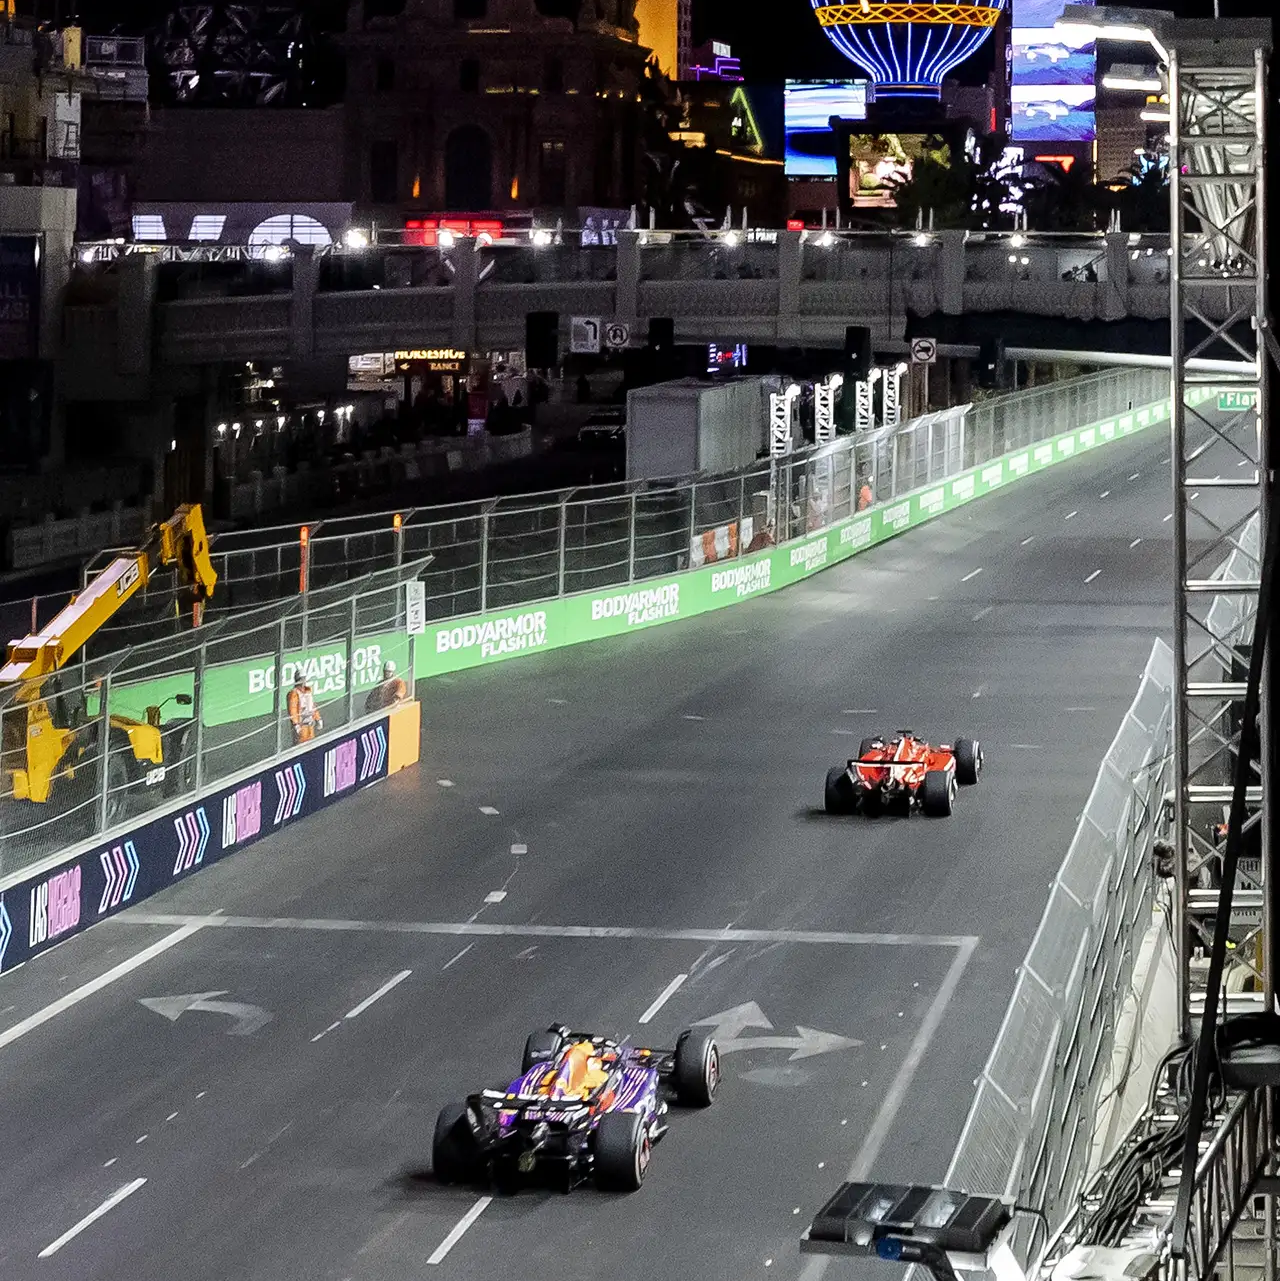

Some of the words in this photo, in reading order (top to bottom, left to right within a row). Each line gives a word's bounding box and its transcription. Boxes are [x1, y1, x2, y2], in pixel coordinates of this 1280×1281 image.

[711, 558, 771, 593] BODYARMOR
[737, 580, 761, 597] FLASH
[591, 582, 680, 620] BODYARMOR
[628, 603, 663, 626] FLASH
[435, 611, 547, 654] BODYARMOR
[481, 631, 528, 658] FLASH
[29, 881, 48, 948] LAS
